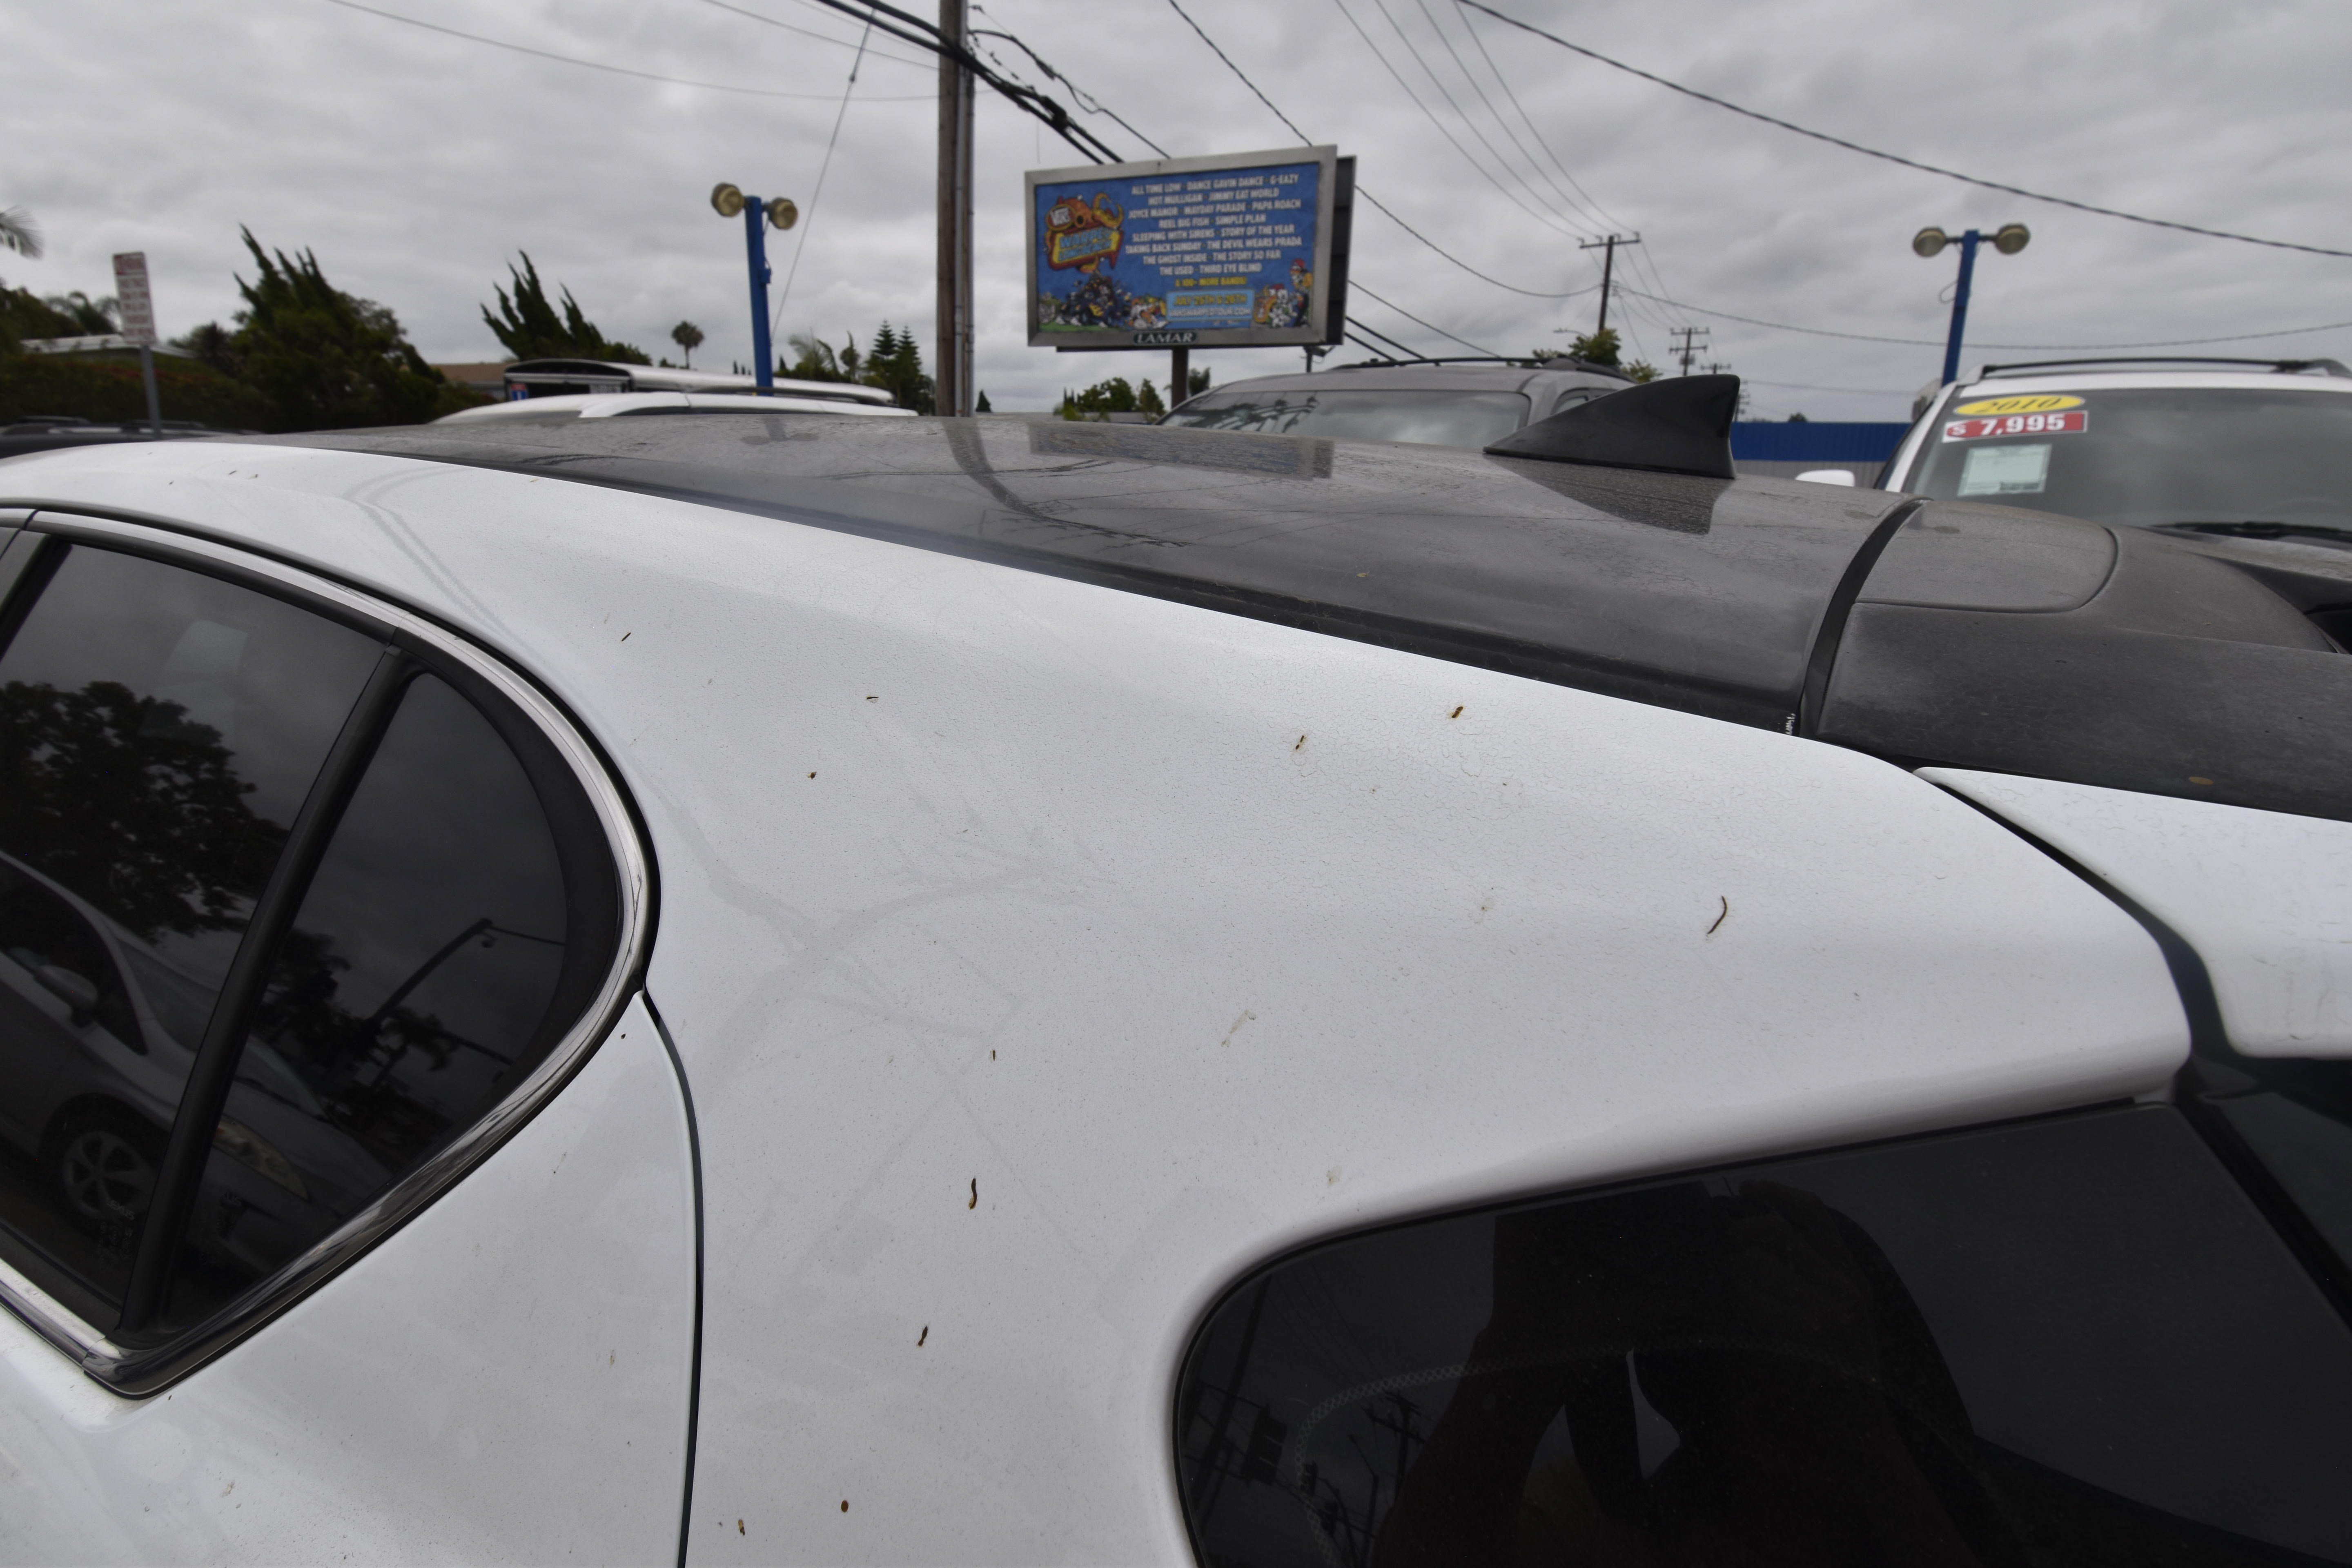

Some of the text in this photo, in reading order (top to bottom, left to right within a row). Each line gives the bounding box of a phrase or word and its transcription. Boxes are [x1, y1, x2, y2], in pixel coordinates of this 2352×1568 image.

[1131, 174, 1299, 195] ALL TIME LOW DANCE GAVIN DANCE G-EAZY
[1148, 187, 1279, 205] HOT MULLIGAN JIMMY EAT WORLD
[1128, 199, 1301, 219] JOYCE MANOR MAYDAY PARADE PAPA ROACH
[1158, 213, 1266, 229] REEL BIG FISH SIMPLE PLAN
[1132, 223, 1295, 242] SLEEPING WITH SIRENS STORY OF THE YEAR
[1125, 236, 1302, 254] TAKING BACK SUNDAY THE DEVIL WEARS PRADA
[1143, 249, 1281, 265] THE GHOST INSIDE THE STORY SO FAR
[1159, 262, 1262, 276] THE USED THIRD EYE BLIND
[1174, 296, 1192, 306] JULY
[1137, 332, 1193, 343] LAMAR
[1973, 397, 2061, 414] 2010
[1980, 413, 2065, 436] 7,995
